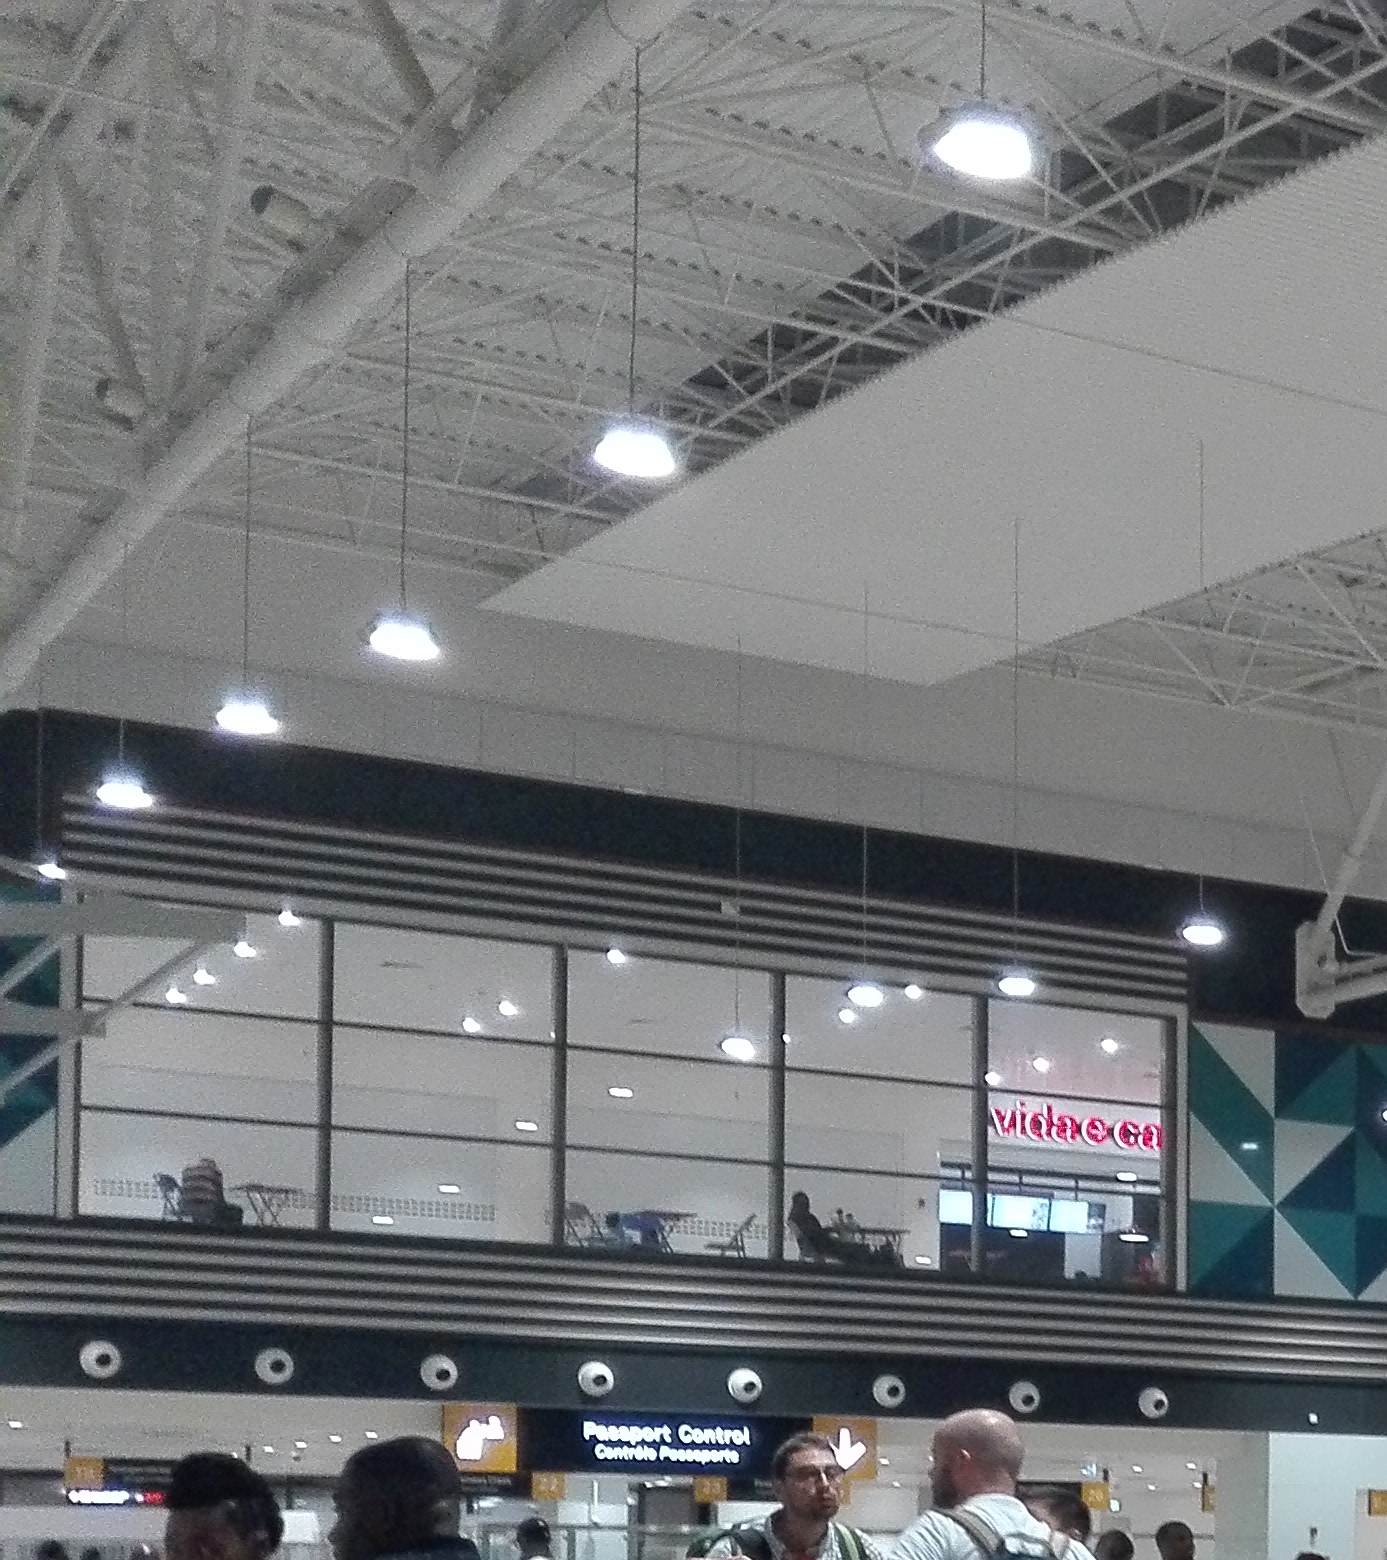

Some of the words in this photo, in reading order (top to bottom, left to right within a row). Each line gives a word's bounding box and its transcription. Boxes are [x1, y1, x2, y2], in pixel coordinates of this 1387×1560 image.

[990, 1101, 1079, 1144] vida
[1080, 1117, 1109, 1147] e
[583, 1420, 672, 1446] Passport
[677, 1424, 751, 1446] Control
